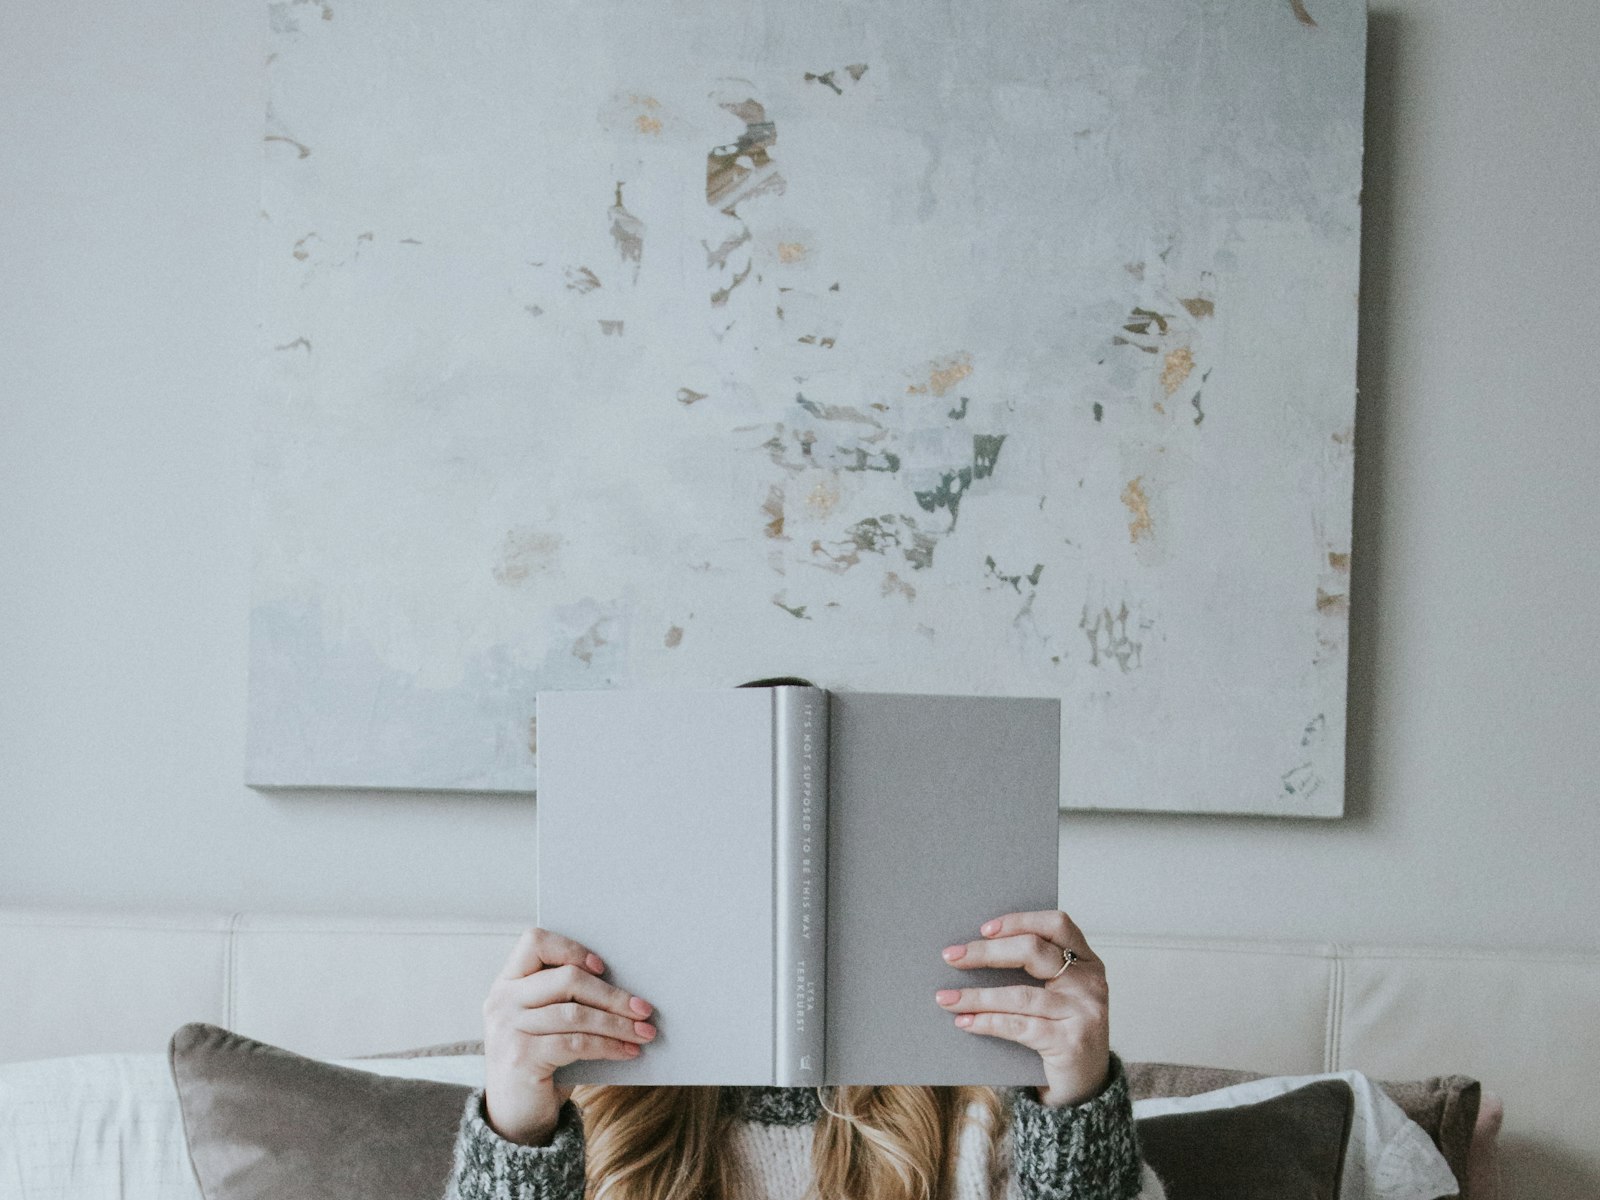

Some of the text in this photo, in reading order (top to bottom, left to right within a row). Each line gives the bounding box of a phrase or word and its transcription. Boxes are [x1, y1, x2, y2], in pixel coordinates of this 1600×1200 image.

[802, 704, 812, 939] IT'S NOT SUPPOSED TO BE THIS WAY
[796, 960, 805, 1032] TERKEURST
[806, 982, 815, 1011] LYSA
